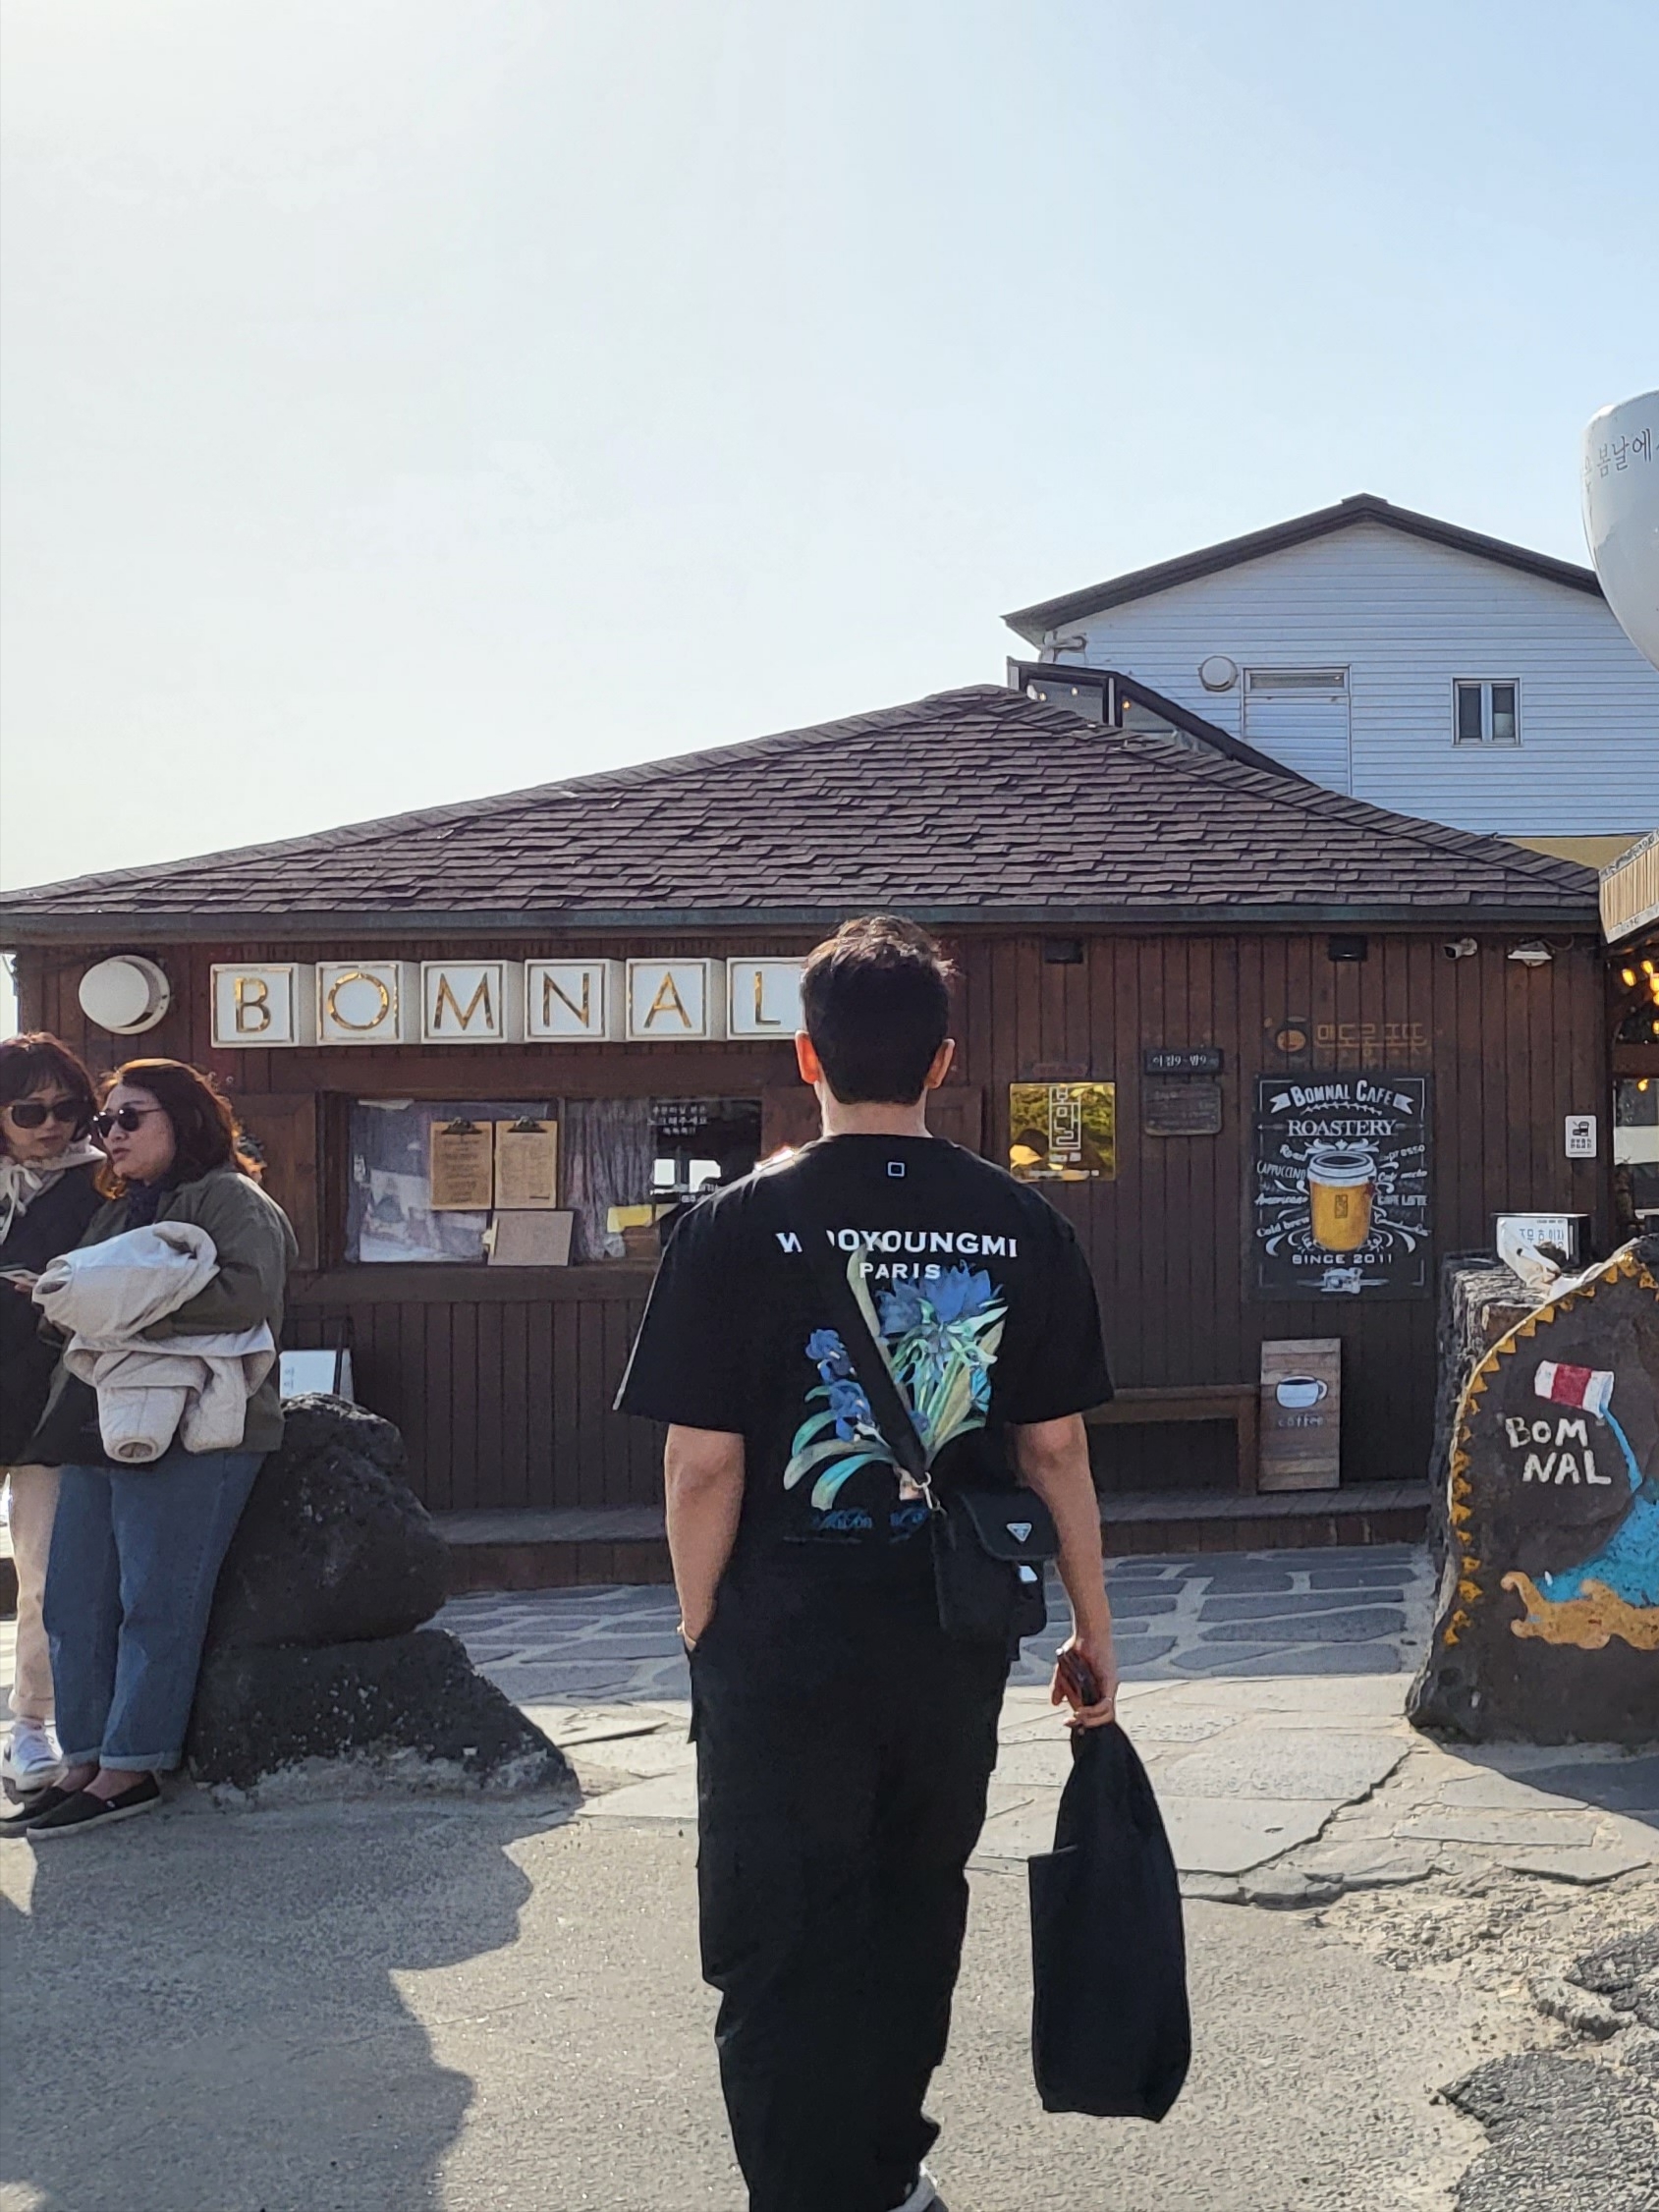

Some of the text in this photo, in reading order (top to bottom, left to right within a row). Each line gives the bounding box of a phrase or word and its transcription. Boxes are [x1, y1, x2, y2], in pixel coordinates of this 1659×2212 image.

[1596, 428, 1659, 478] 봄날에
[233, 970, 782, 1034] BOMNAL
[1355, 1079, 1393, 1106] CAFE
[1287, 1118, 1397, 1137] ROASTERY
[1256, 1159, 1307, 1180] CAPPUCCINO
[775, 1229, 1018, 1257] WOYOUNGMI
[858, 1262, 943, 1281] PARIS
[1292, 1252, 1393, 1265] SINCE 2011
[1505, 1416, 1589, 1449] BOM
[1521, 1449, 1613, 1485] NAL
